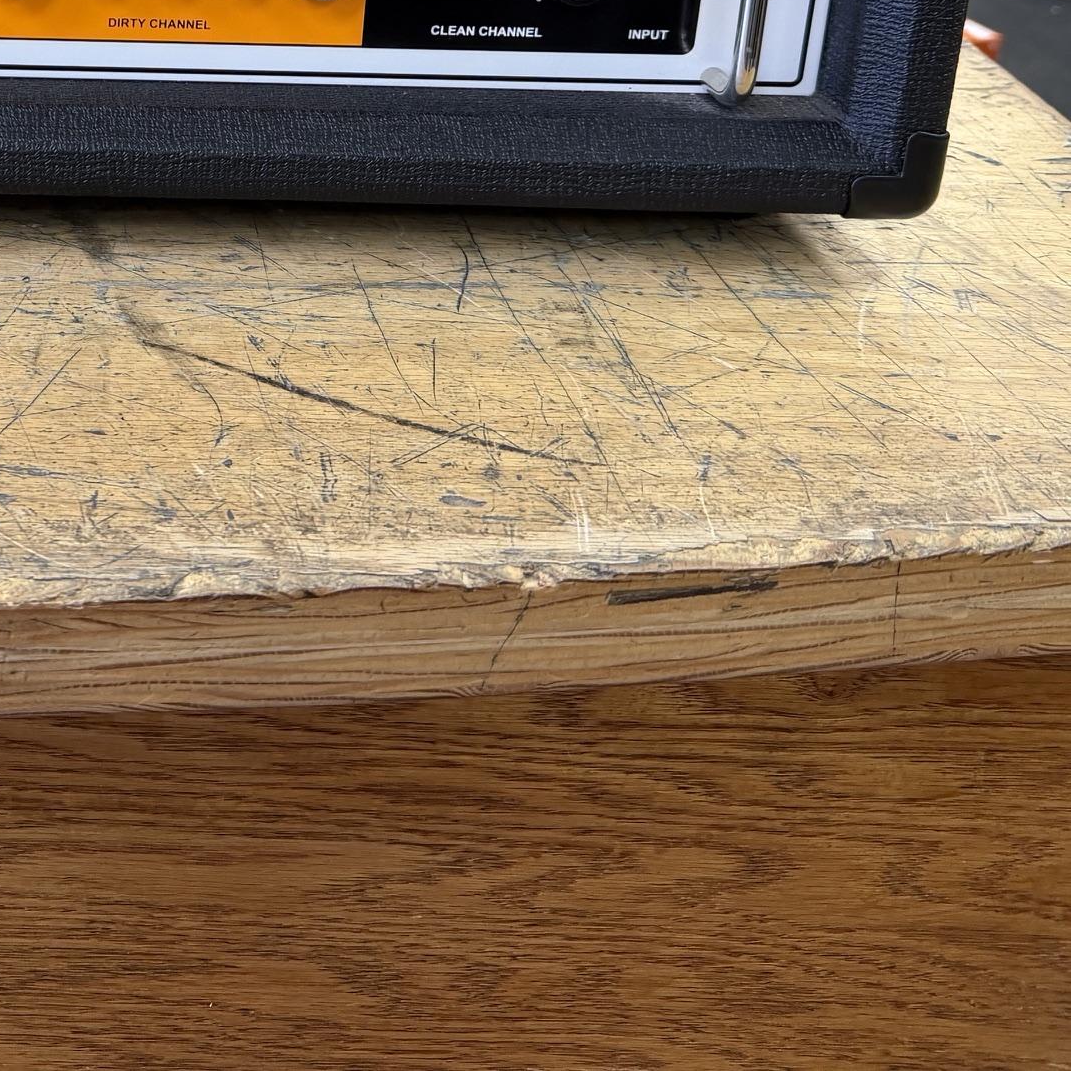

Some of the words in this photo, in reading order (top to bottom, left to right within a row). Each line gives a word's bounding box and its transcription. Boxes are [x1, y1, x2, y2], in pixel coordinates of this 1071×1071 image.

[107, 16, 147, 29] DIRTY
[149, 18, 211, 30] CHANNEL
[430, 24, 476, 37] CLEAN
[478, 25, 543, 38] CHANNEL
[627, 28, 670, 41] INPUT
